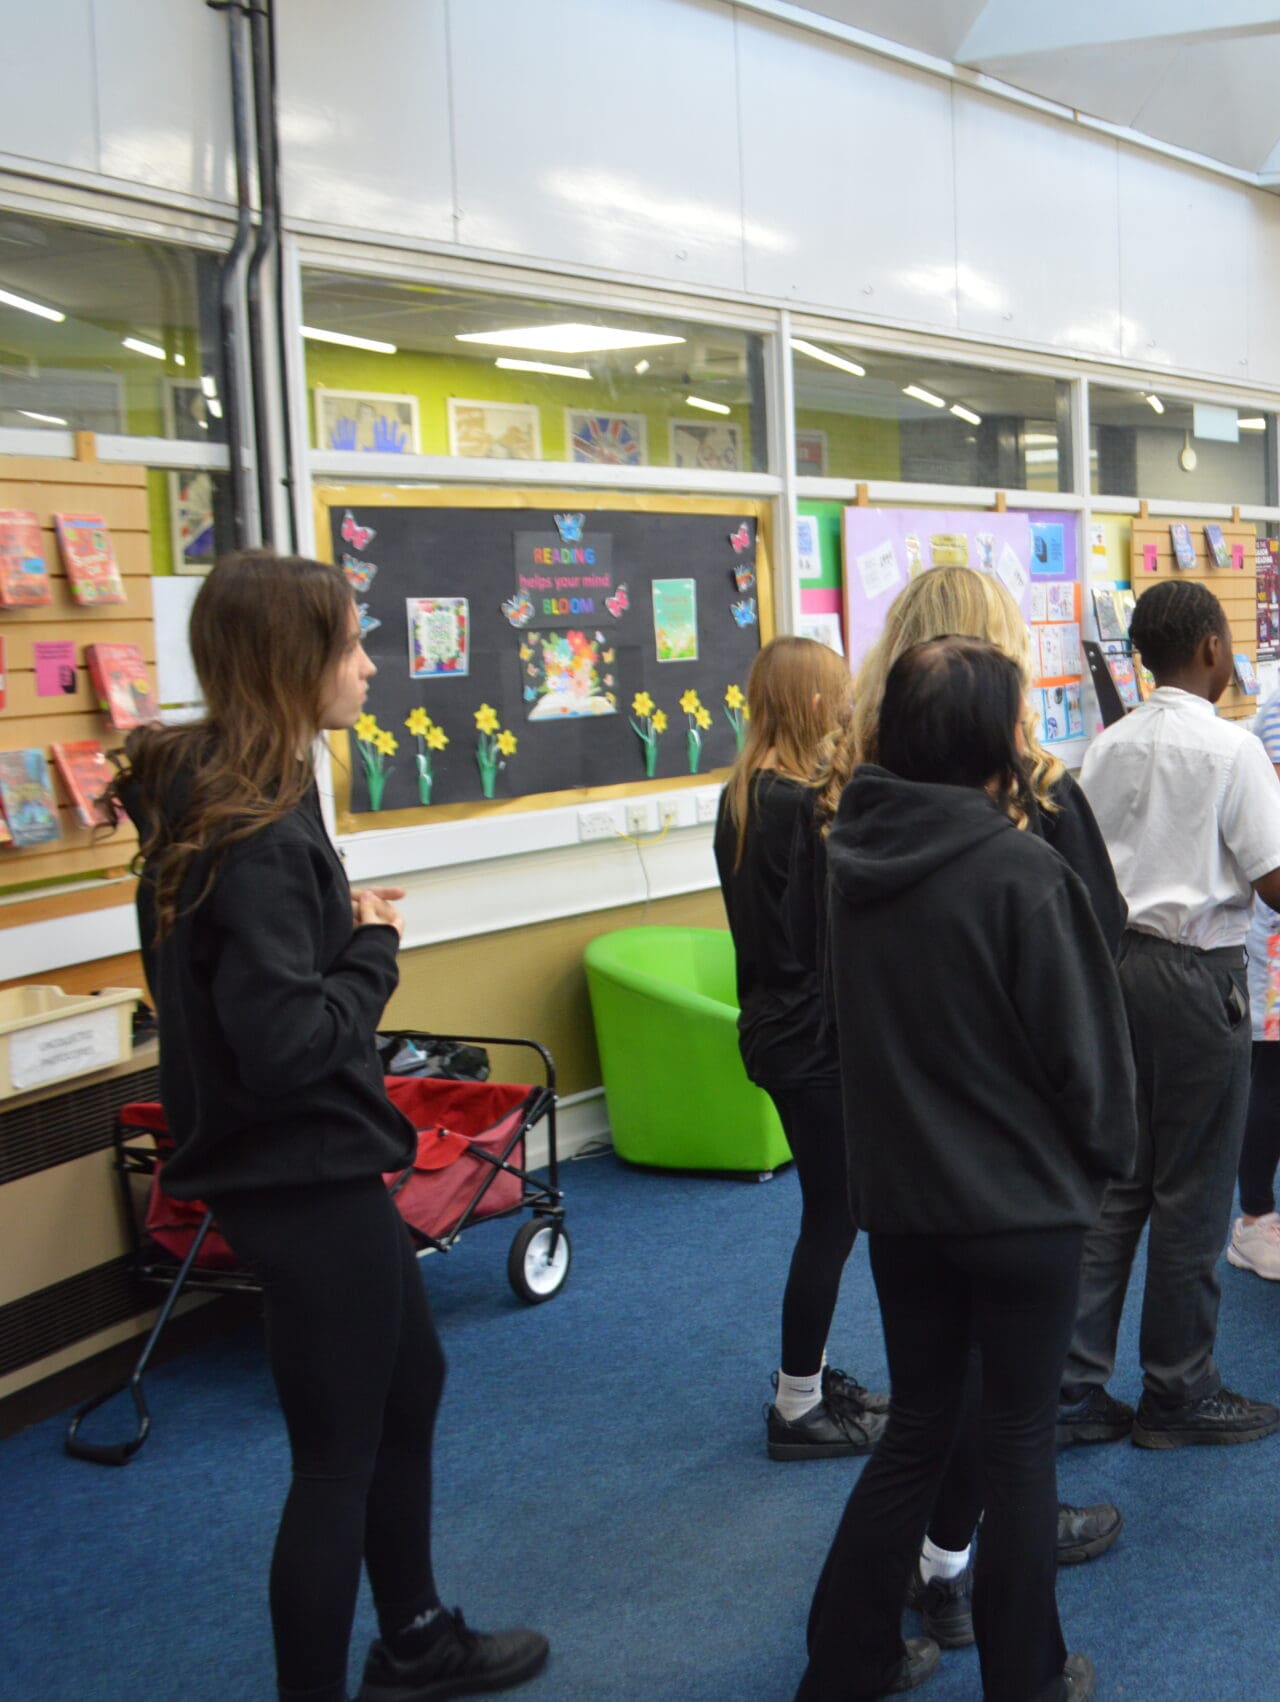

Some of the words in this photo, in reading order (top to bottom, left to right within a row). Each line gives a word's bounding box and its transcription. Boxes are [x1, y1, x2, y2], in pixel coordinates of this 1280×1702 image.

[534, 547, 596, 565] READING
[519, 573, 552, 591] helps
[554, 577, 580, 591] your
[582, 573, 611, 588] mind
[543, 598, 594, 615] BLOOM
